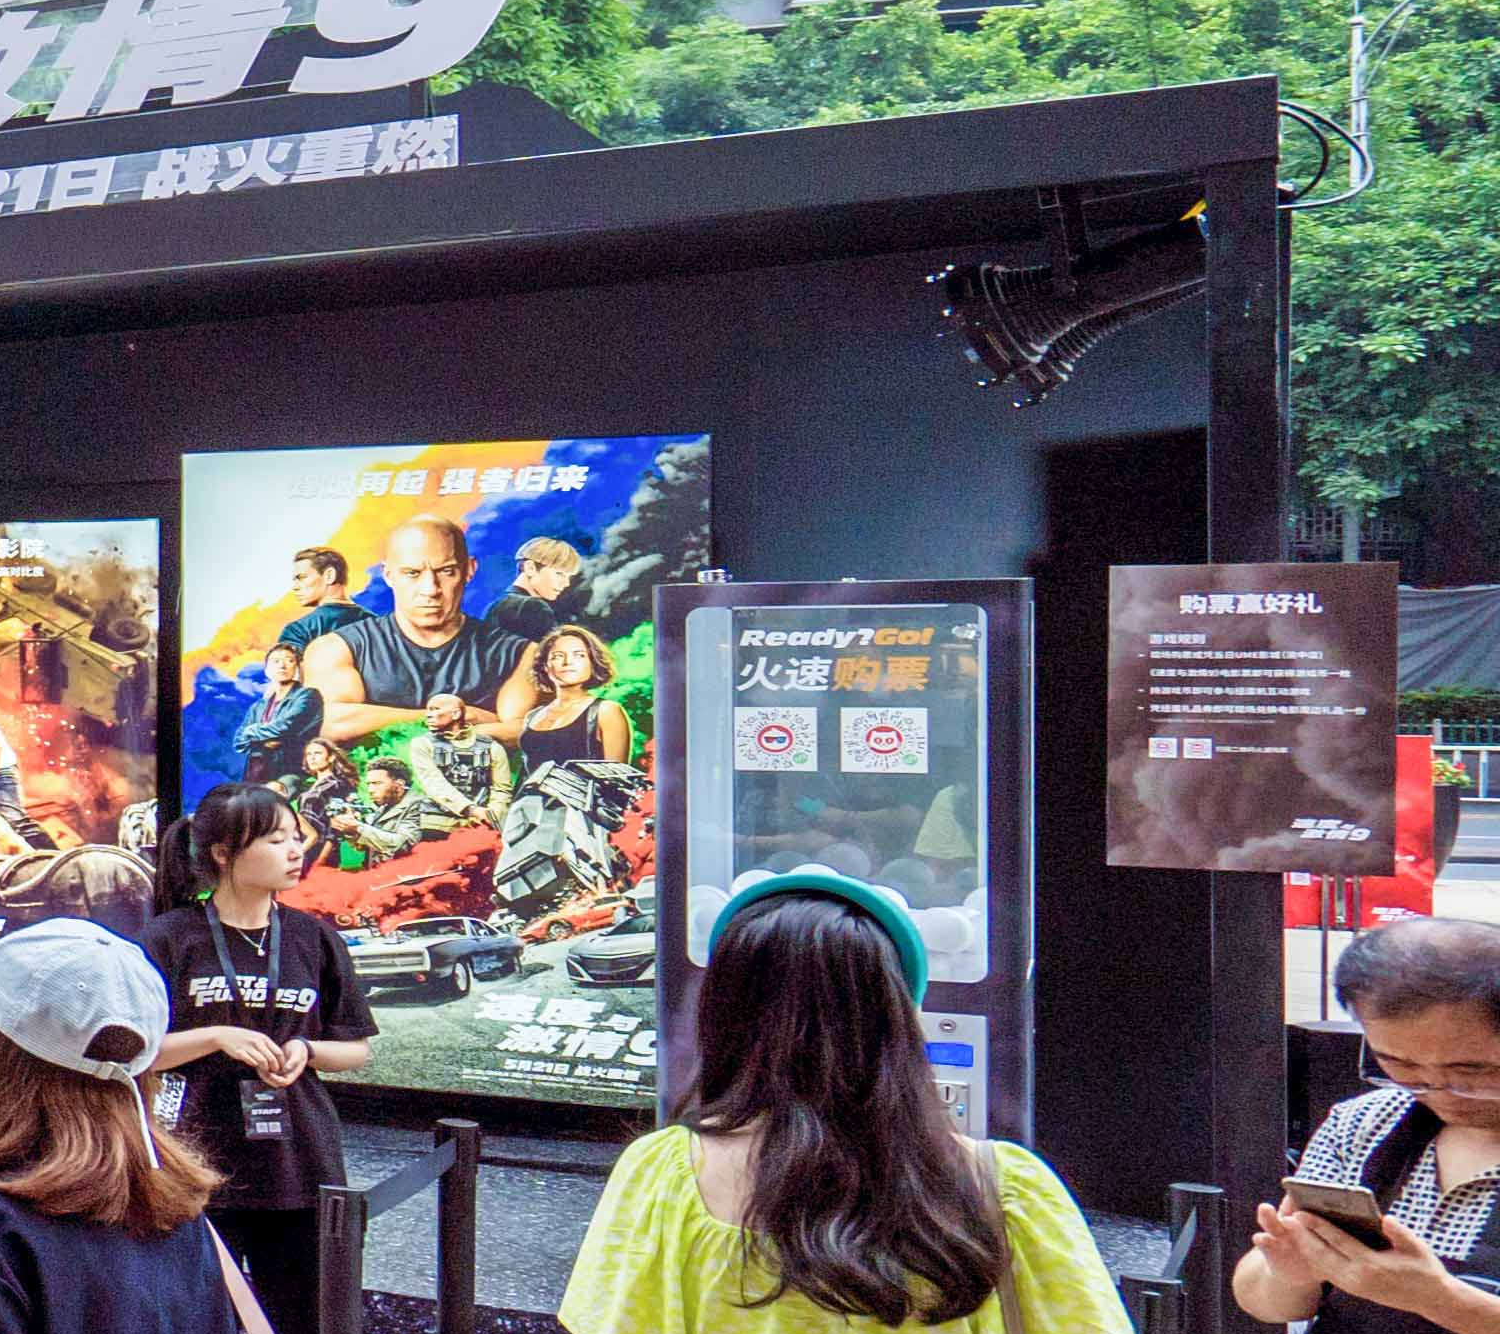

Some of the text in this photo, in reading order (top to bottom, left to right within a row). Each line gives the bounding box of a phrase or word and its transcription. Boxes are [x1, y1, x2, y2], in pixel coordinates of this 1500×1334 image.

[142, 117, 457, 201] 战火重燃
[439, 466, 589, 496] 强者归来
[1179, 592, 1324, 615] 购票赢好礼
[735, 655, 932, 692] 火速购票
[474, 994, 643, 1032] 速度与
